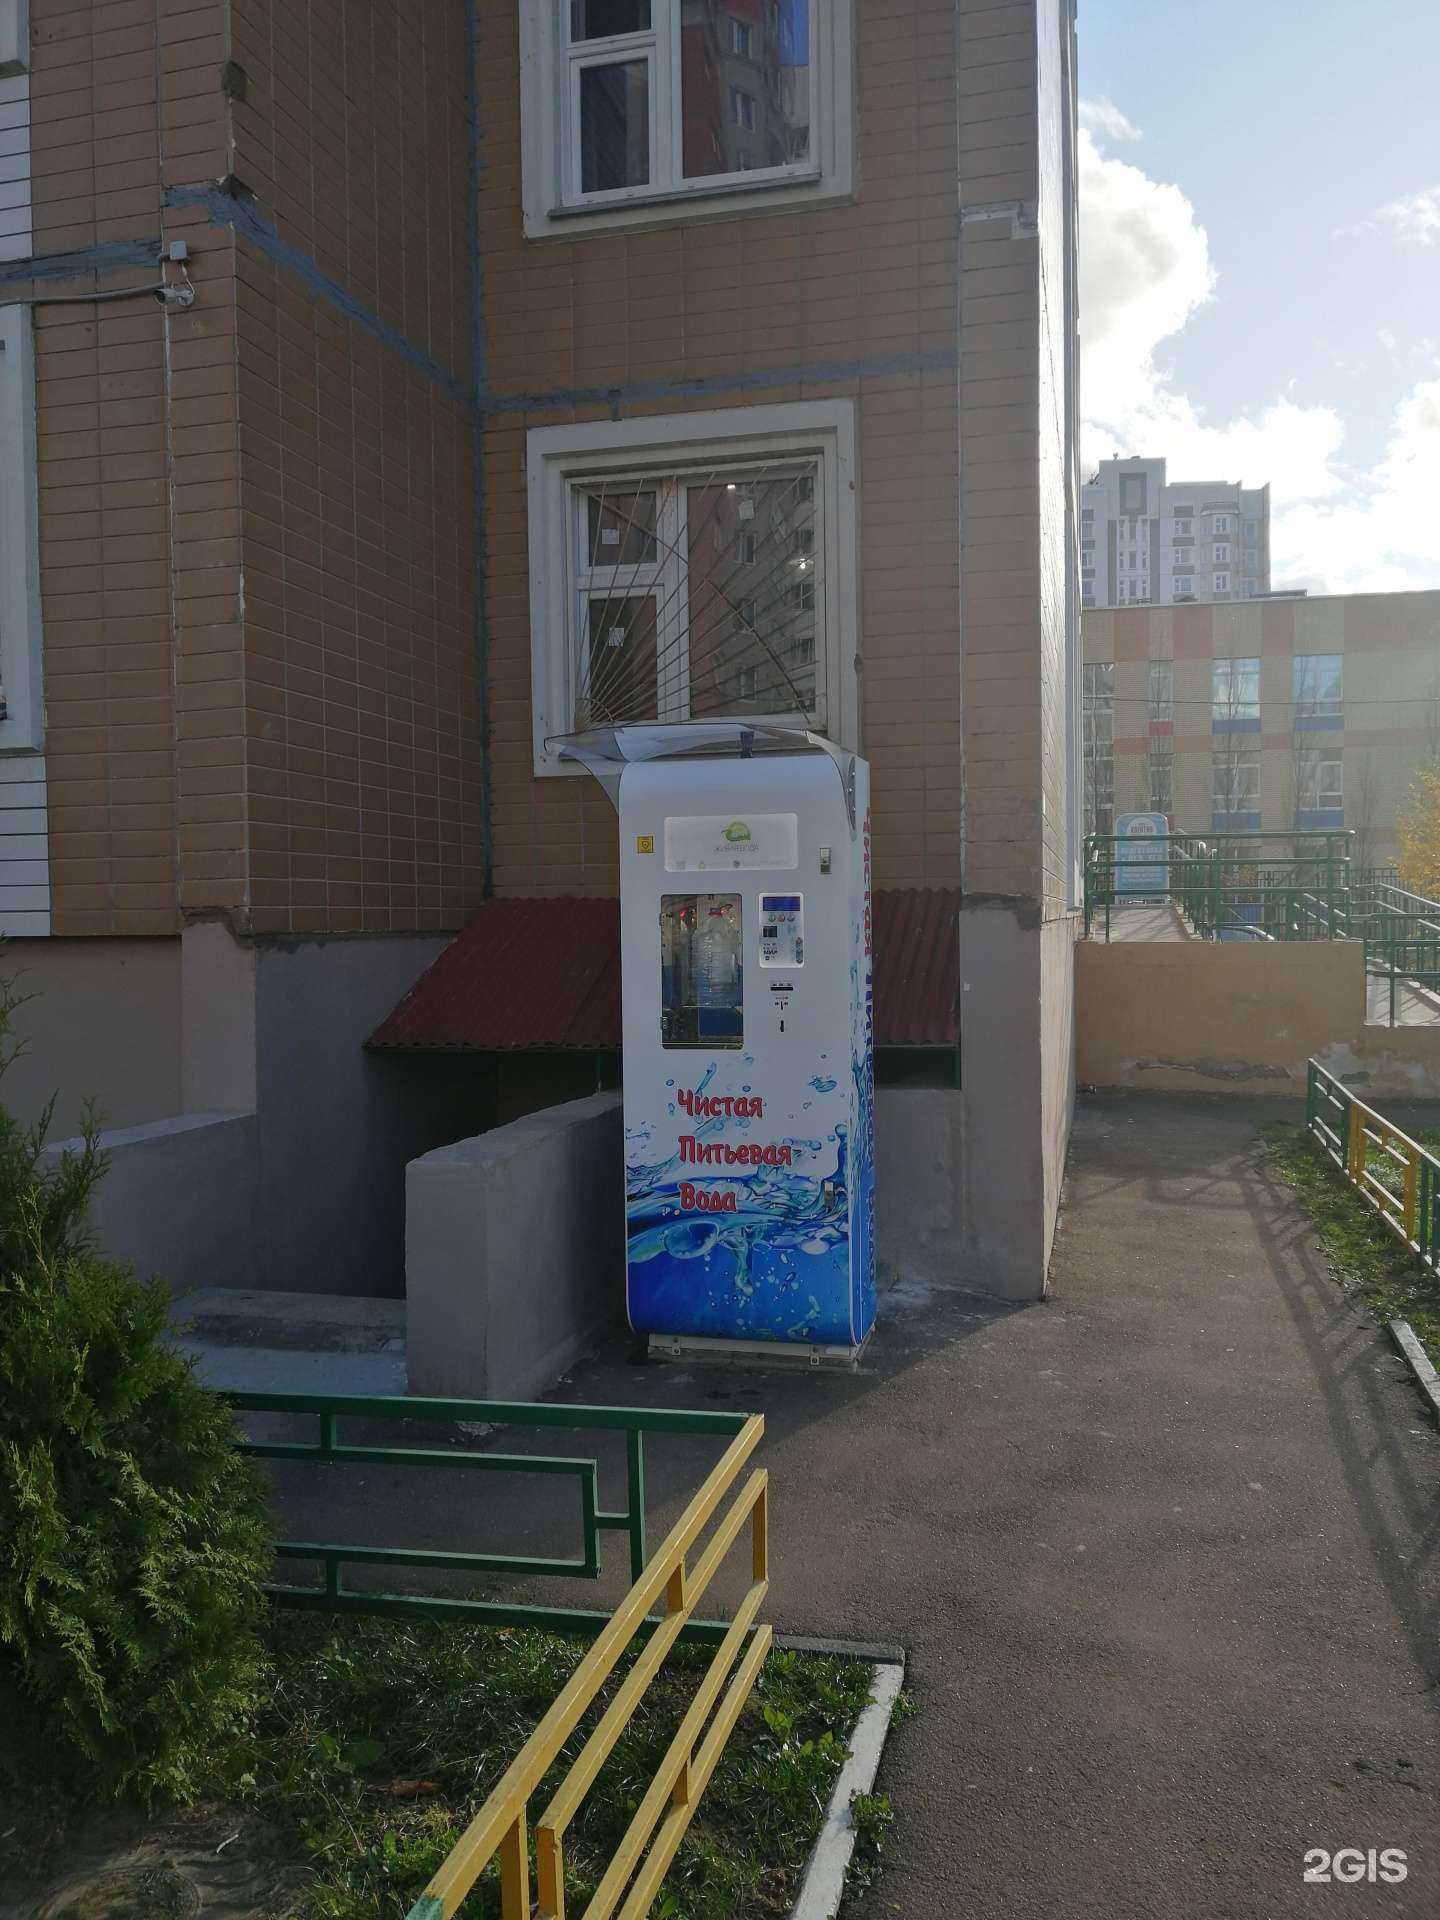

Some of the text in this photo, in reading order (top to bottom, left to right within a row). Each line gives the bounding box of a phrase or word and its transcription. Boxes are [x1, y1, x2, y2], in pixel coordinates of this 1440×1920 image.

[677, 1088, 763, 1118] Чистая
[678, 1135, 793, 1166] Питьевая
[679, 1182, 737, 1213] Вода
